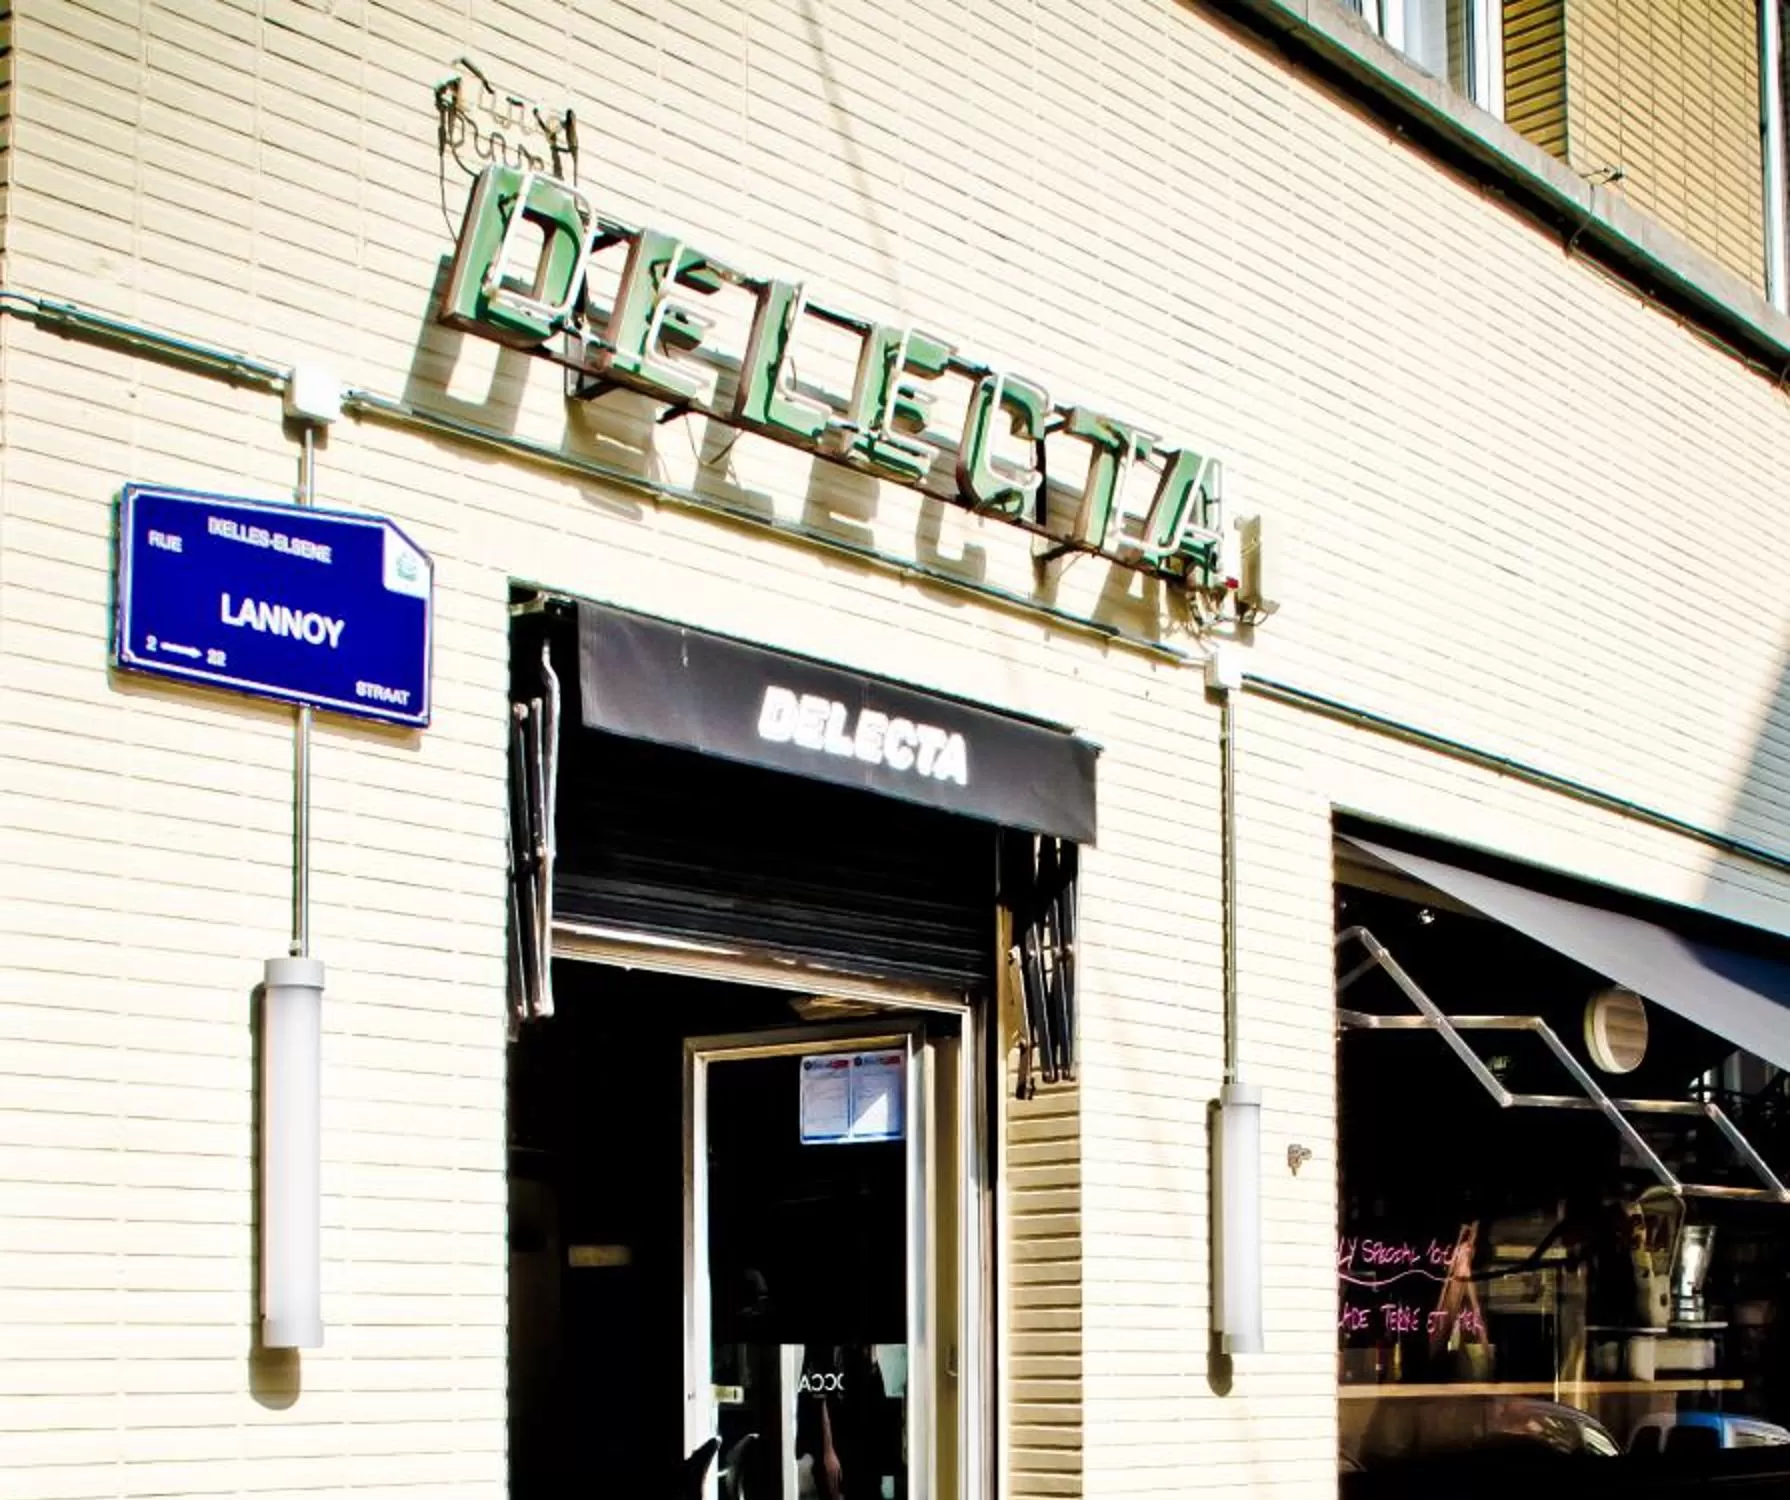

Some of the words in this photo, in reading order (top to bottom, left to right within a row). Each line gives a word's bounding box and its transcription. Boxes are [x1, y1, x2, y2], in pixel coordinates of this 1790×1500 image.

[439, 164, 1224, 590] DELECTA
[148, 529, 183, 553] RUE
[221, 592, 345, 648] LANNOY
[355, 680, 411, 706] STRAAT
[757, 685, 968, 786] DELECTA
